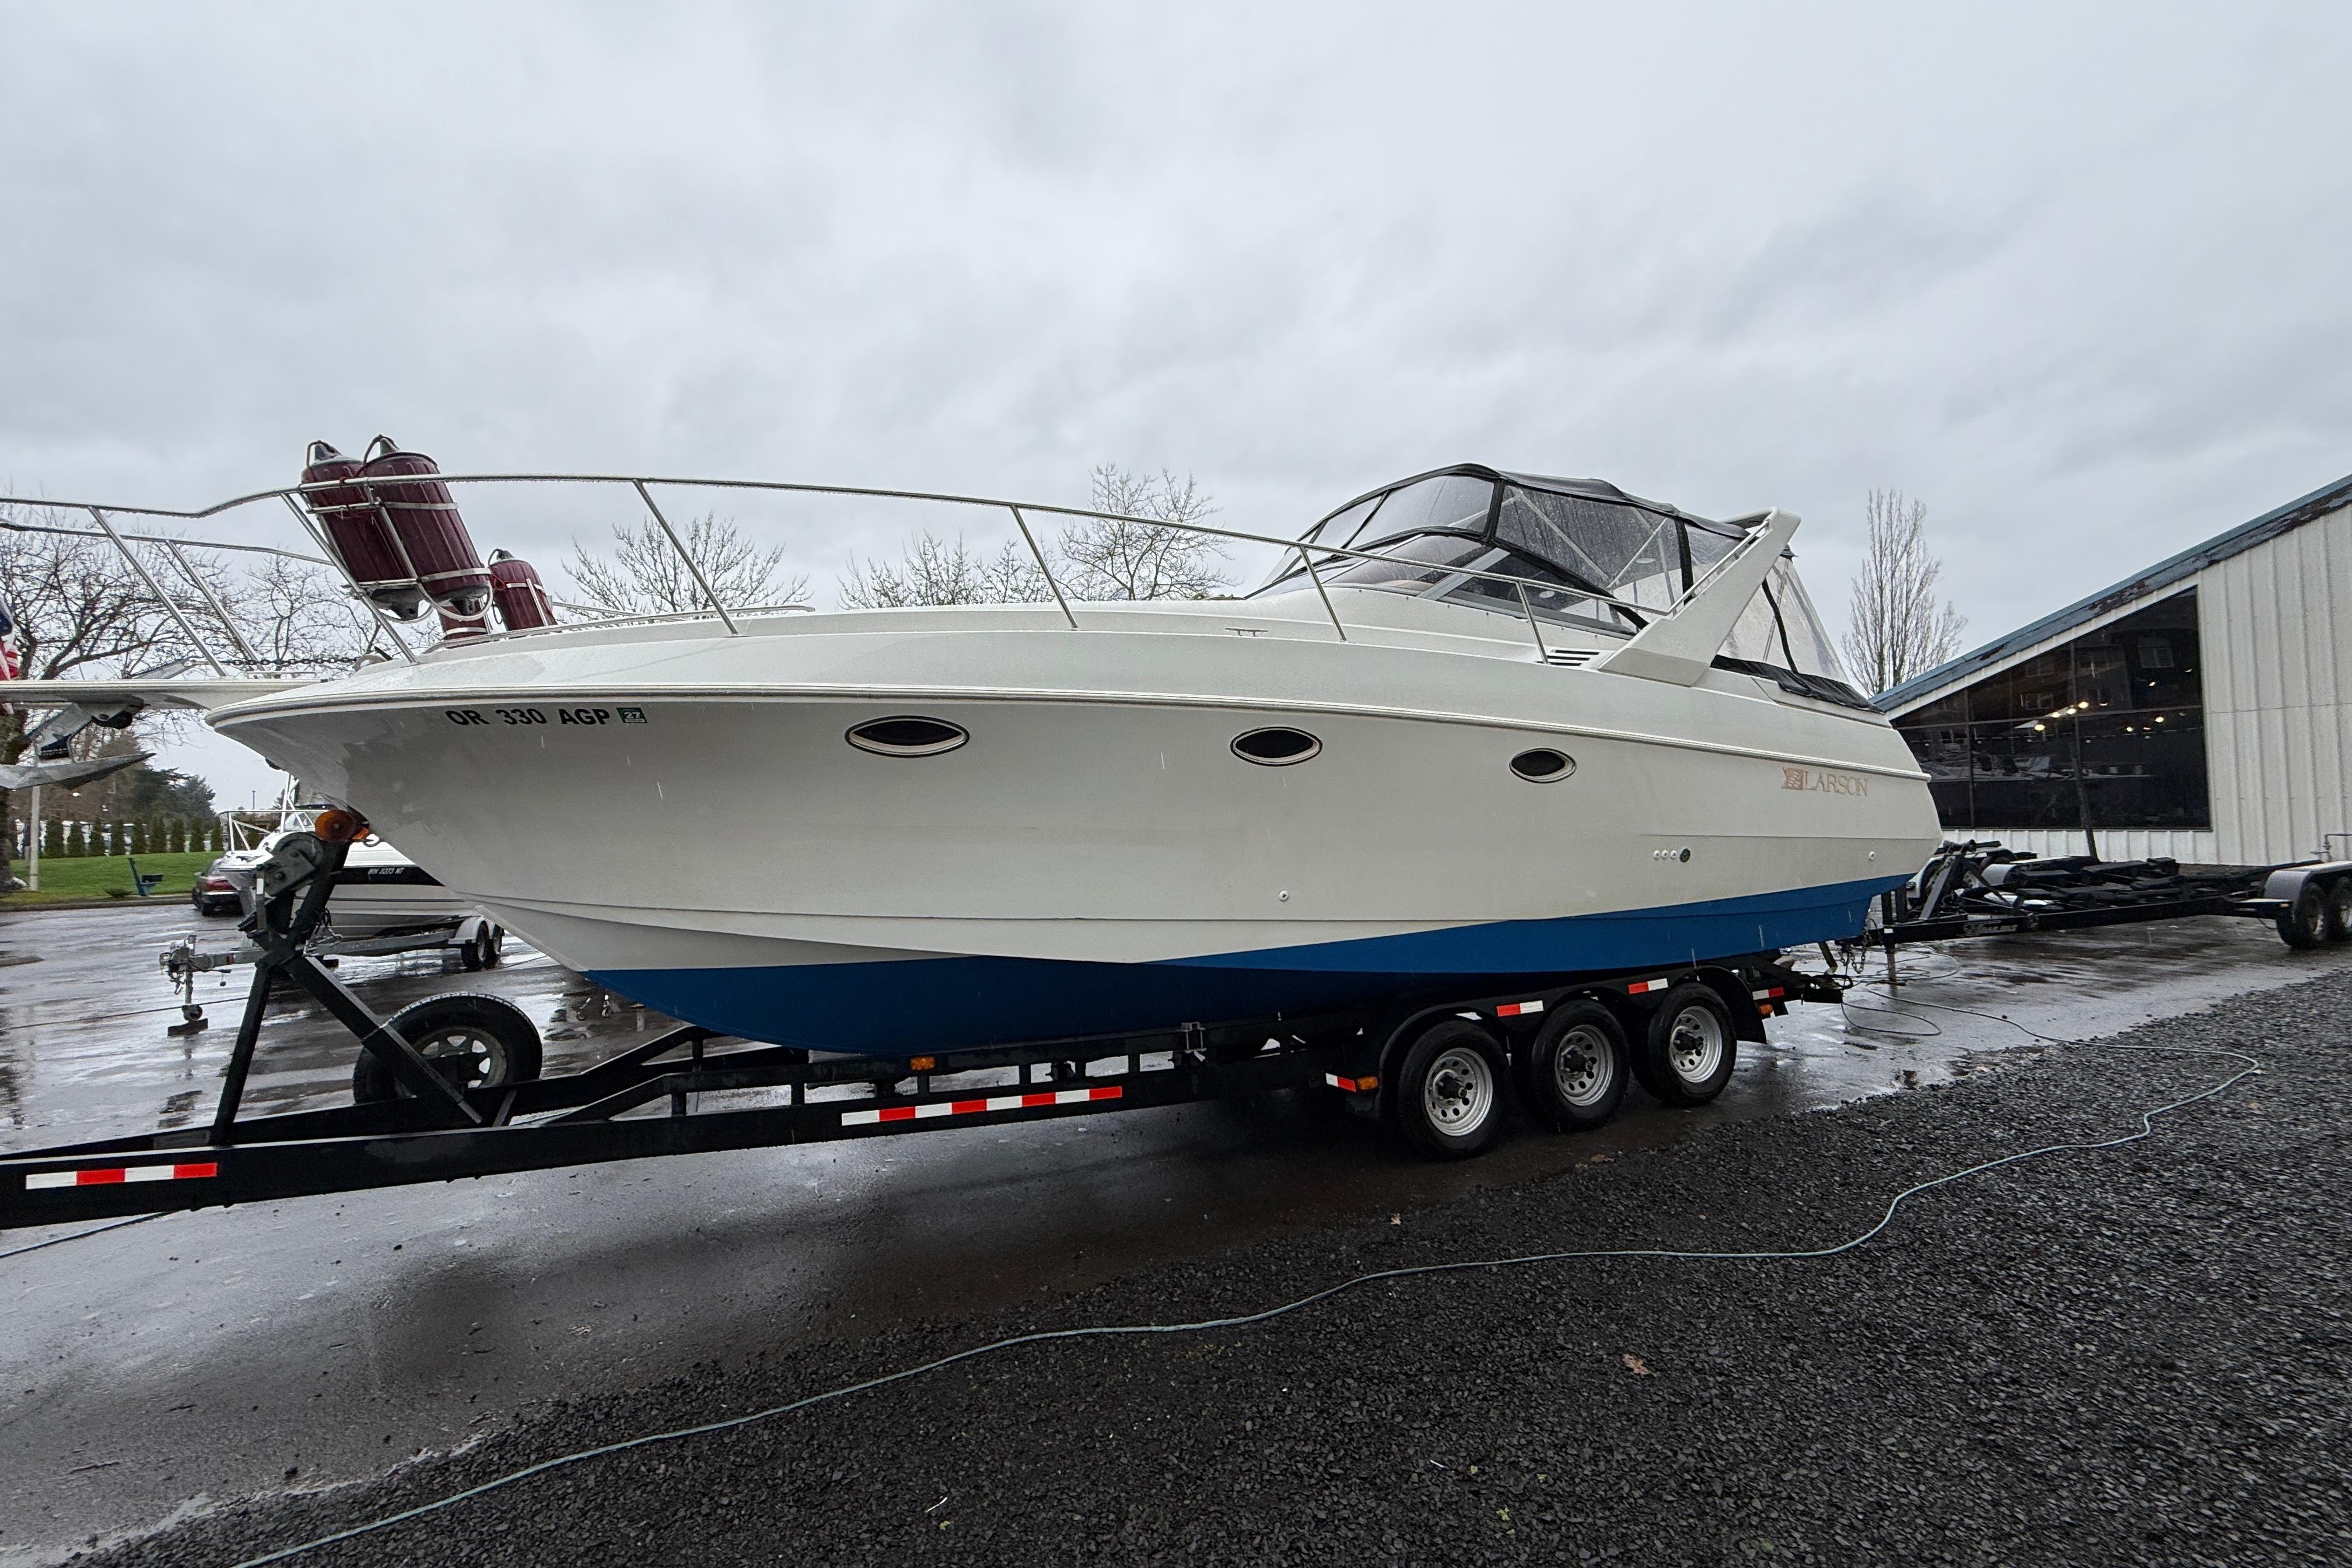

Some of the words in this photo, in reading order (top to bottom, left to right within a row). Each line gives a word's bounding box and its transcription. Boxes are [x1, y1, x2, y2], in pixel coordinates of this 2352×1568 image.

[445, 710, 491, 725] OR
[495, 708, 547, 724] 330
[558, 708, 610, 724] AGP
[1804, 771, 1868, 796] LARSON
